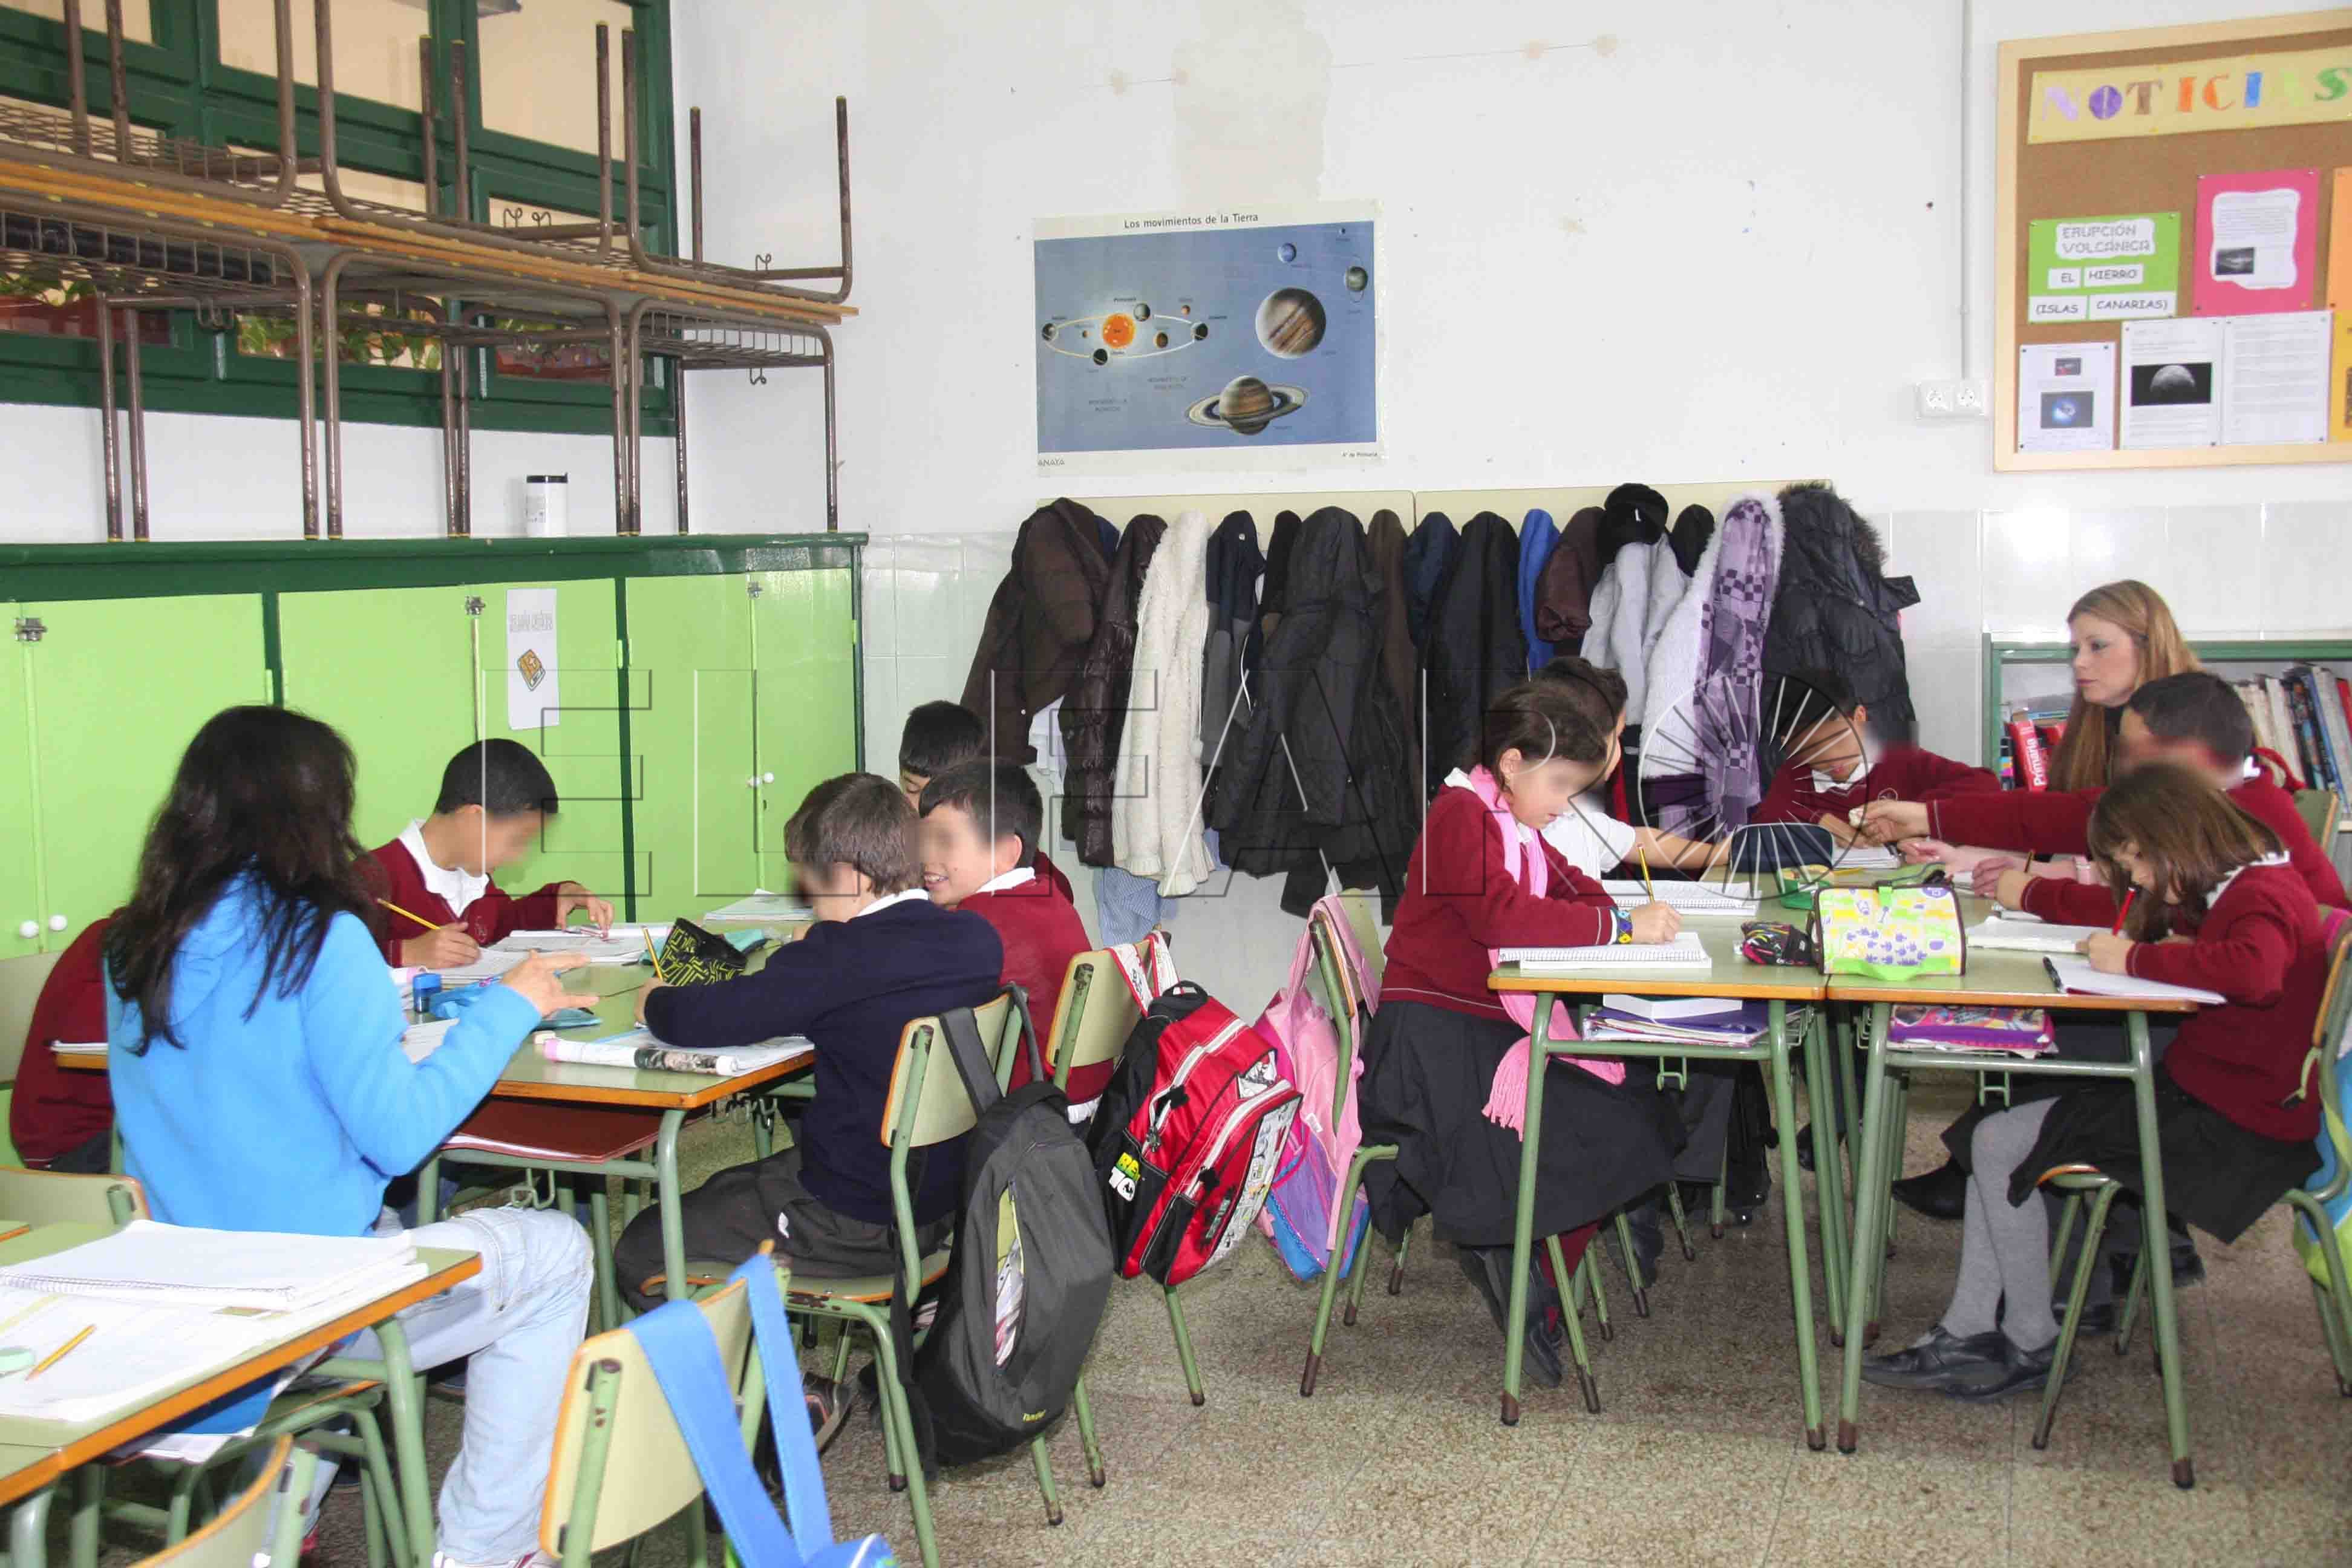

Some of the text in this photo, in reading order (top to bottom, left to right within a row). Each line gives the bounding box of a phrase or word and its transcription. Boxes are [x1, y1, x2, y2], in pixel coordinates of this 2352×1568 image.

[2041, 67, 2351, 121] NOTICIAS
[1124, 214, 1258, 229] Los movimientos de la Tierra
[2062, 223, 2137, 239] ERUPCIÓN
[2061, 269, 2137, 283] EL HIERRO
[2036, 299, 2168, 313] (ISLAS CANARIAS)
[2027, 737, 2047, 786] Primaria
